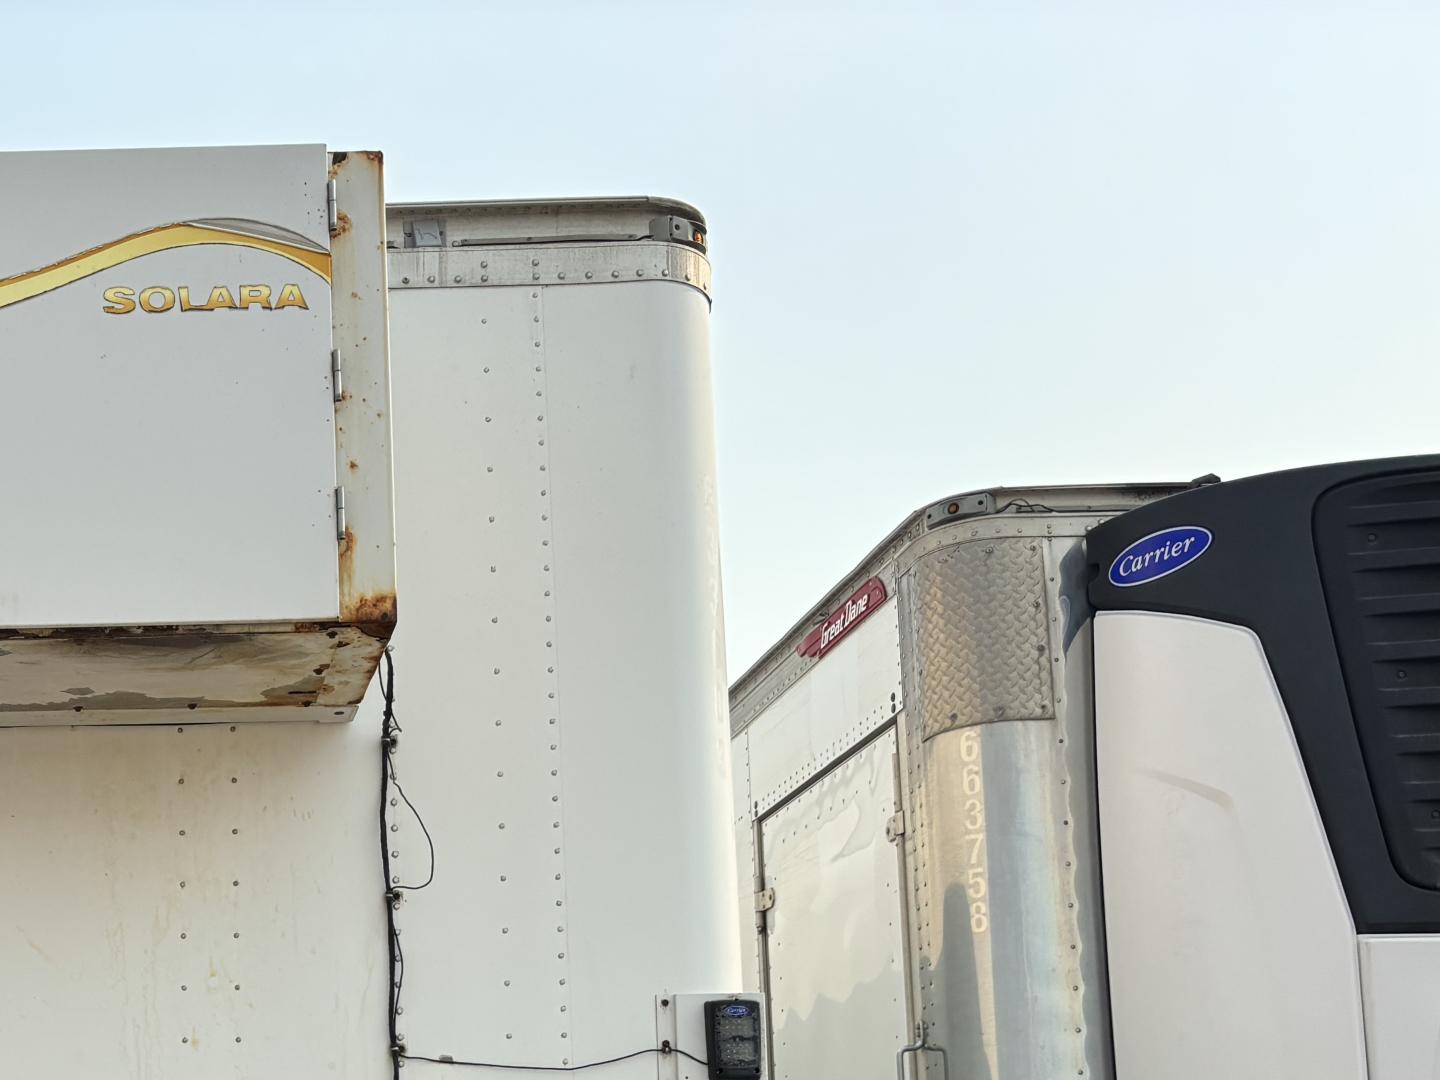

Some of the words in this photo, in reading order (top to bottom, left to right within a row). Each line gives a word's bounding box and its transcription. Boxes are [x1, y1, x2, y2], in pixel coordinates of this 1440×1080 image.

[102, 283, 309, 314] SOLARA
[1119, 536, 1195, 577] Carrier
[820, 612, 845, 649] Great
[843, 593, 868, 629] Dane
[960, 731, 987, 933] 663758
